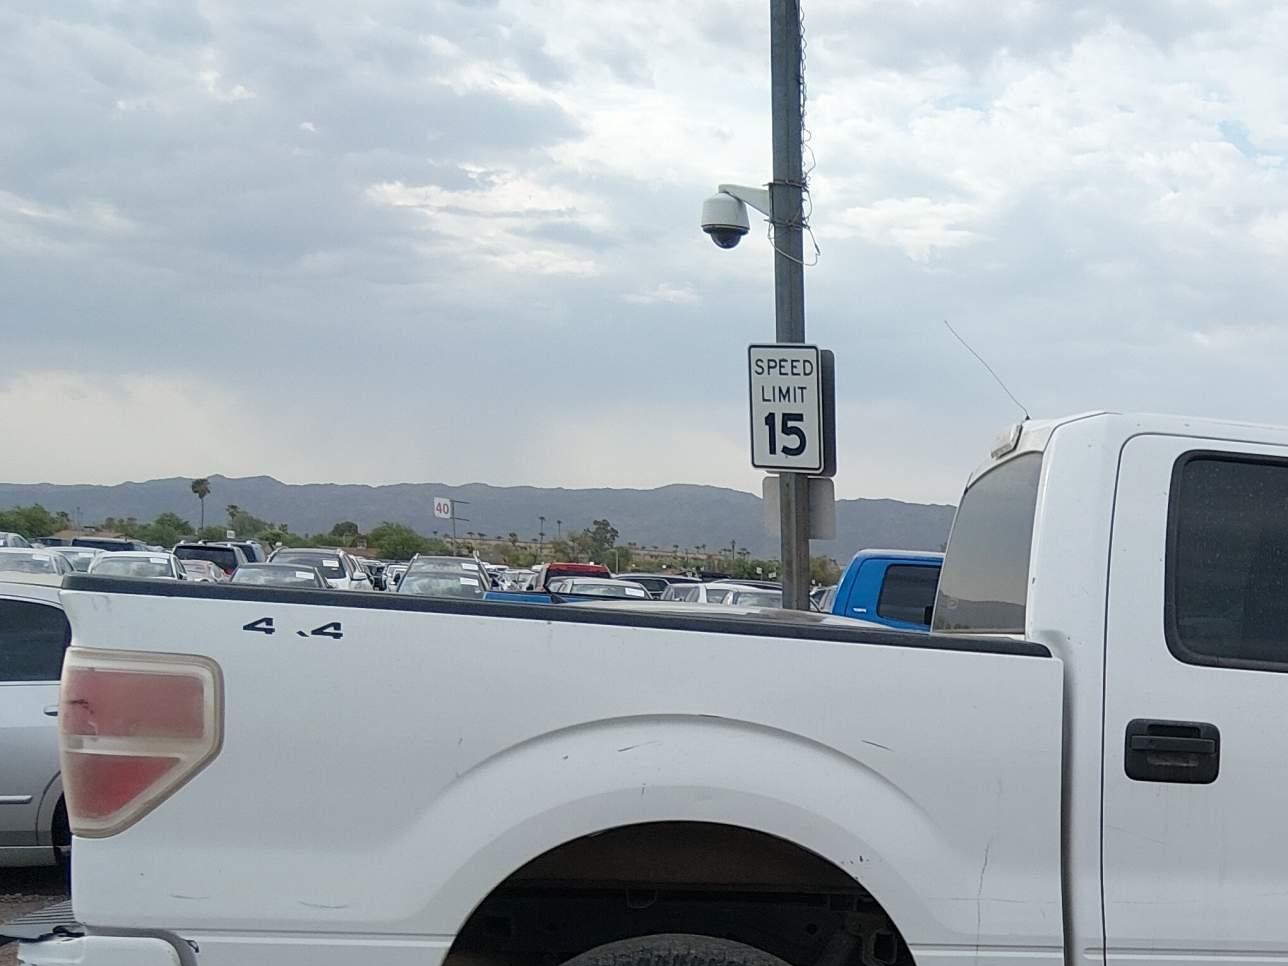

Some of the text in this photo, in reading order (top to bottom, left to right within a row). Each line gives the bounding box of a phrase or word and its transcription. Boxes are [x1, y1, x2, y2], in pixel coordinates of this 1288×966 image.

[755, 358, 814, 377] SPEED
[761, 385, 807, 403] LIMIT
[764, 412, 807, 456] 15
[436, 502, 450, 515] 40
